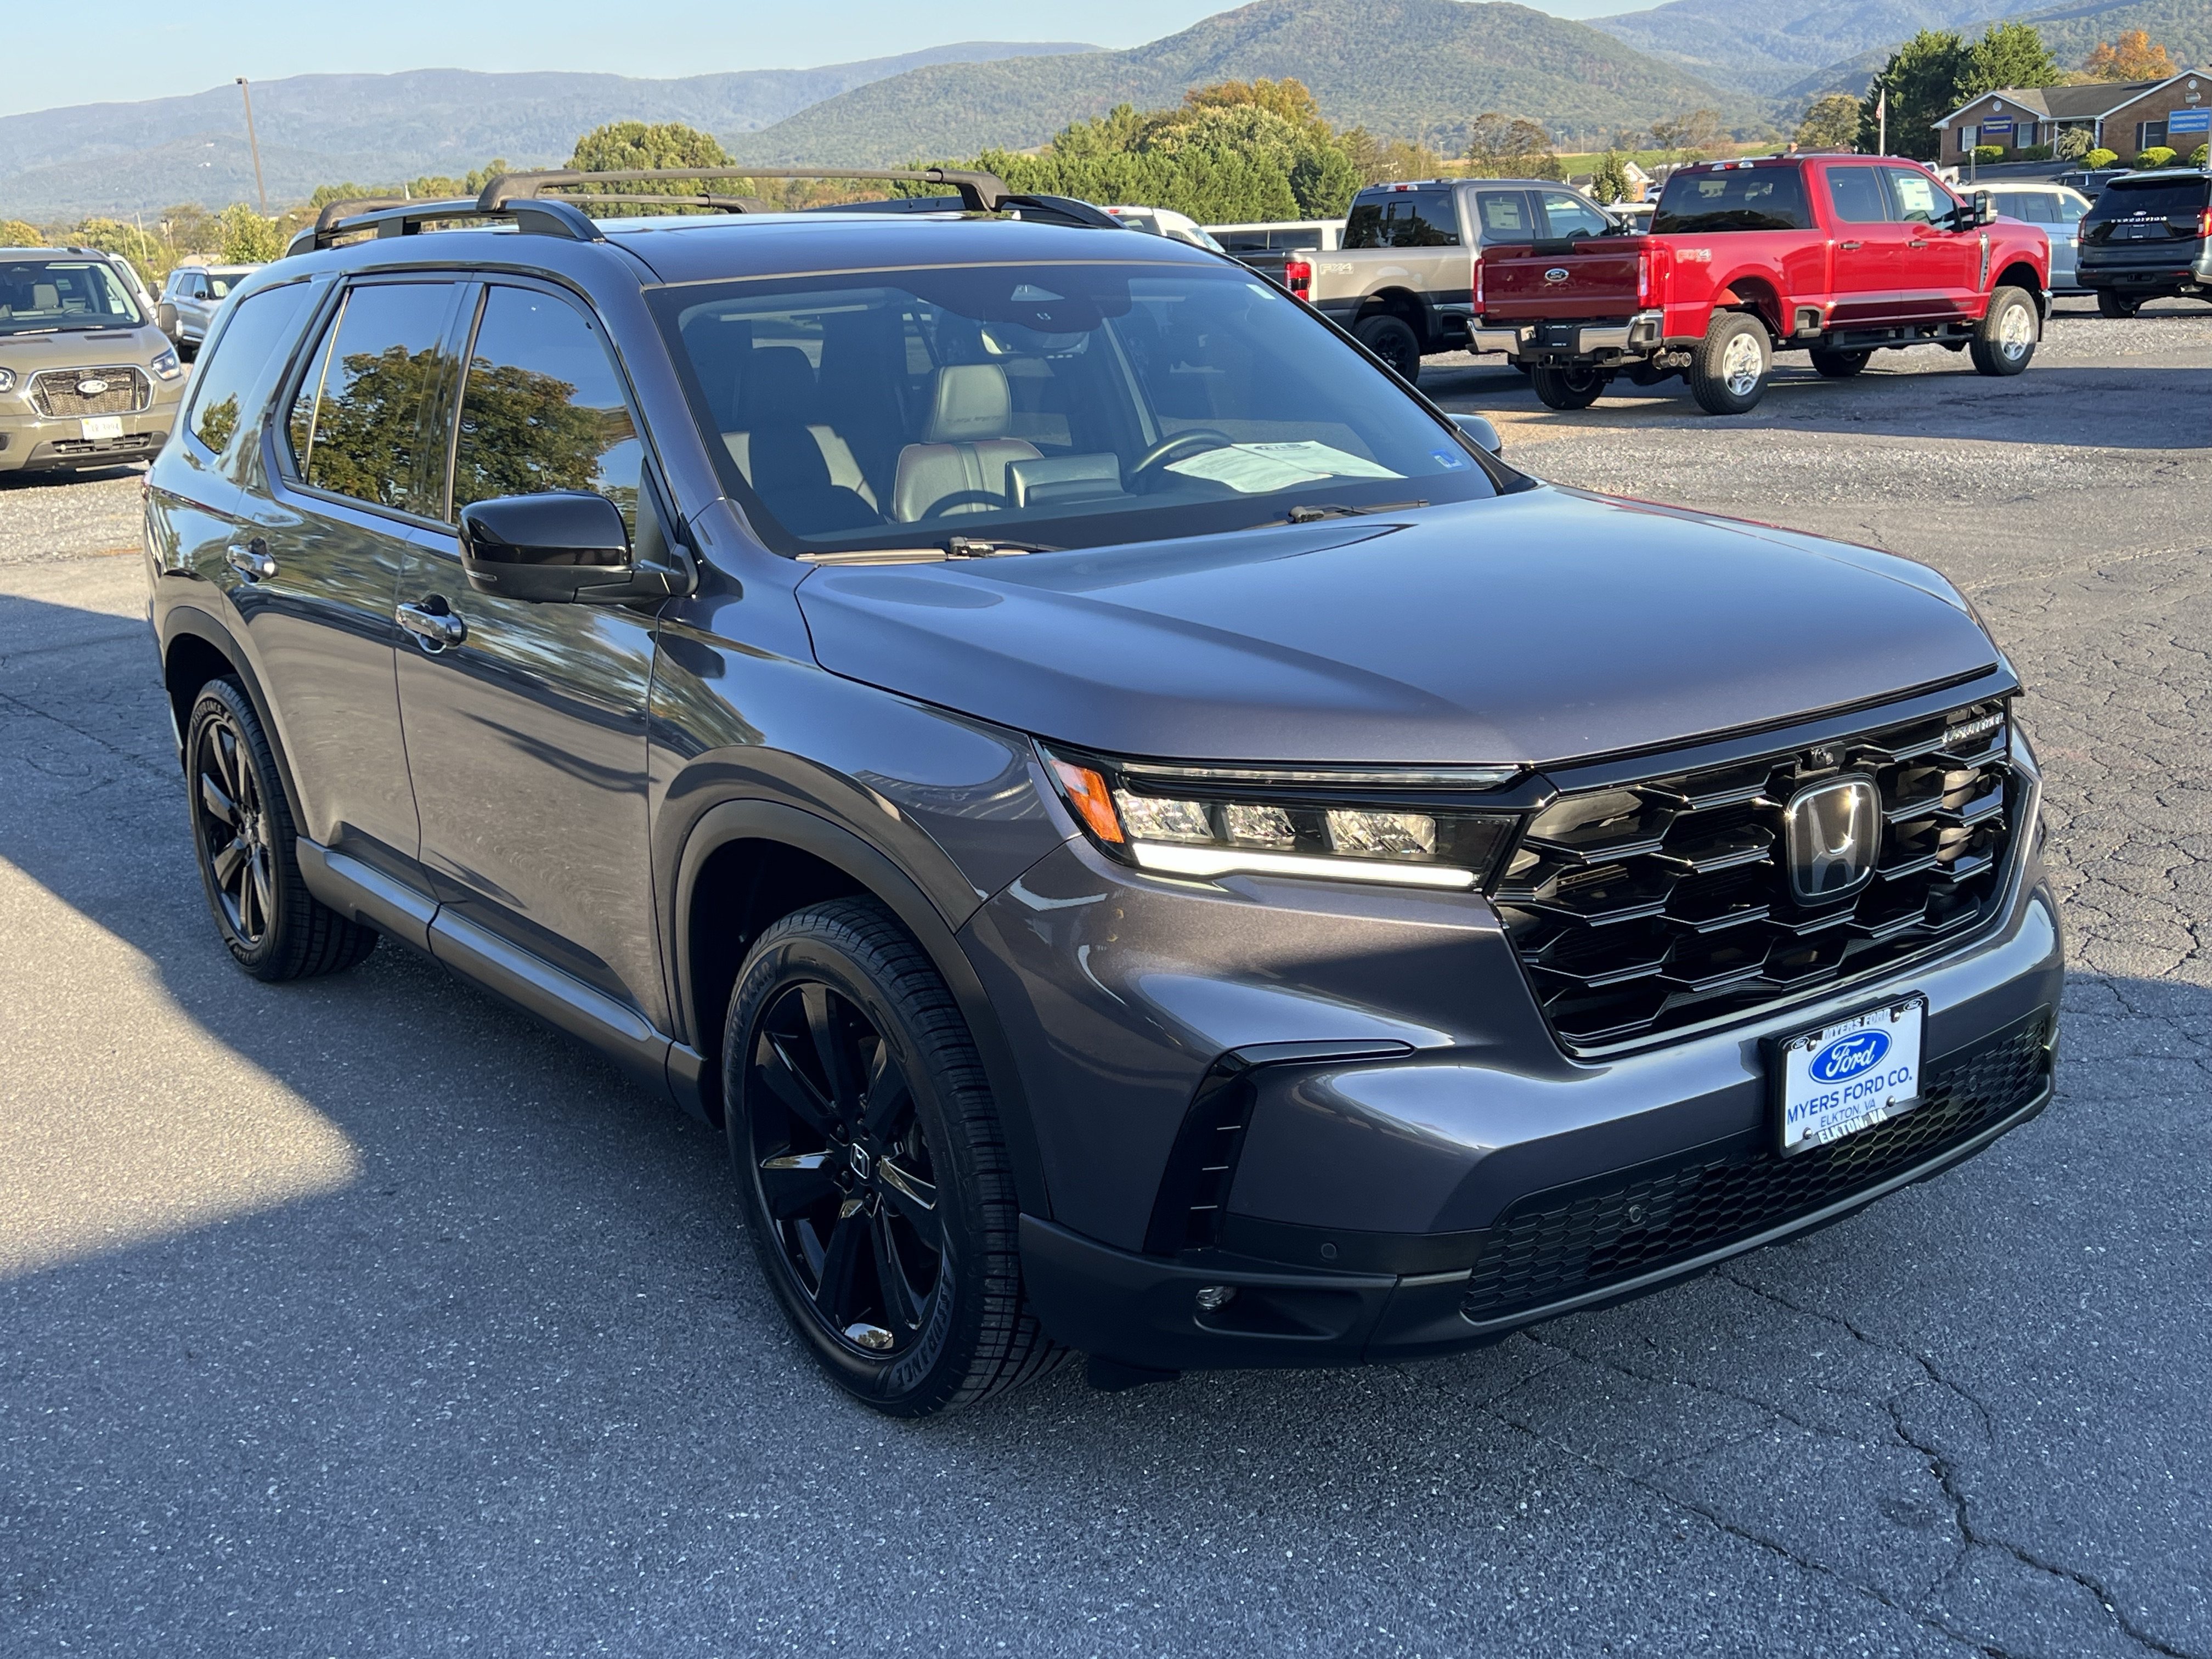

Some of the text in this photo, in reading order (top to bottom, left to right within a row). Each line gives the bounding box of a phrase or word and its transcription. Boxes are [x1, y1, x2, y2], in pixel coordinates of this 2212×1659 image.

[1677, 249, 1711, 263] FX4
[1320, 263, 1353, 274] FX4
[1822, 1008, 1892, 1040] MYERS FORD
[1826, 1038, 1876, 1077] Ford
[1787, 1066, 1912, 1125] MYERS FORD CO.
[1865, 1098, 1876, 1110] VA
[1869, 1108, 1888, 1123] VA
